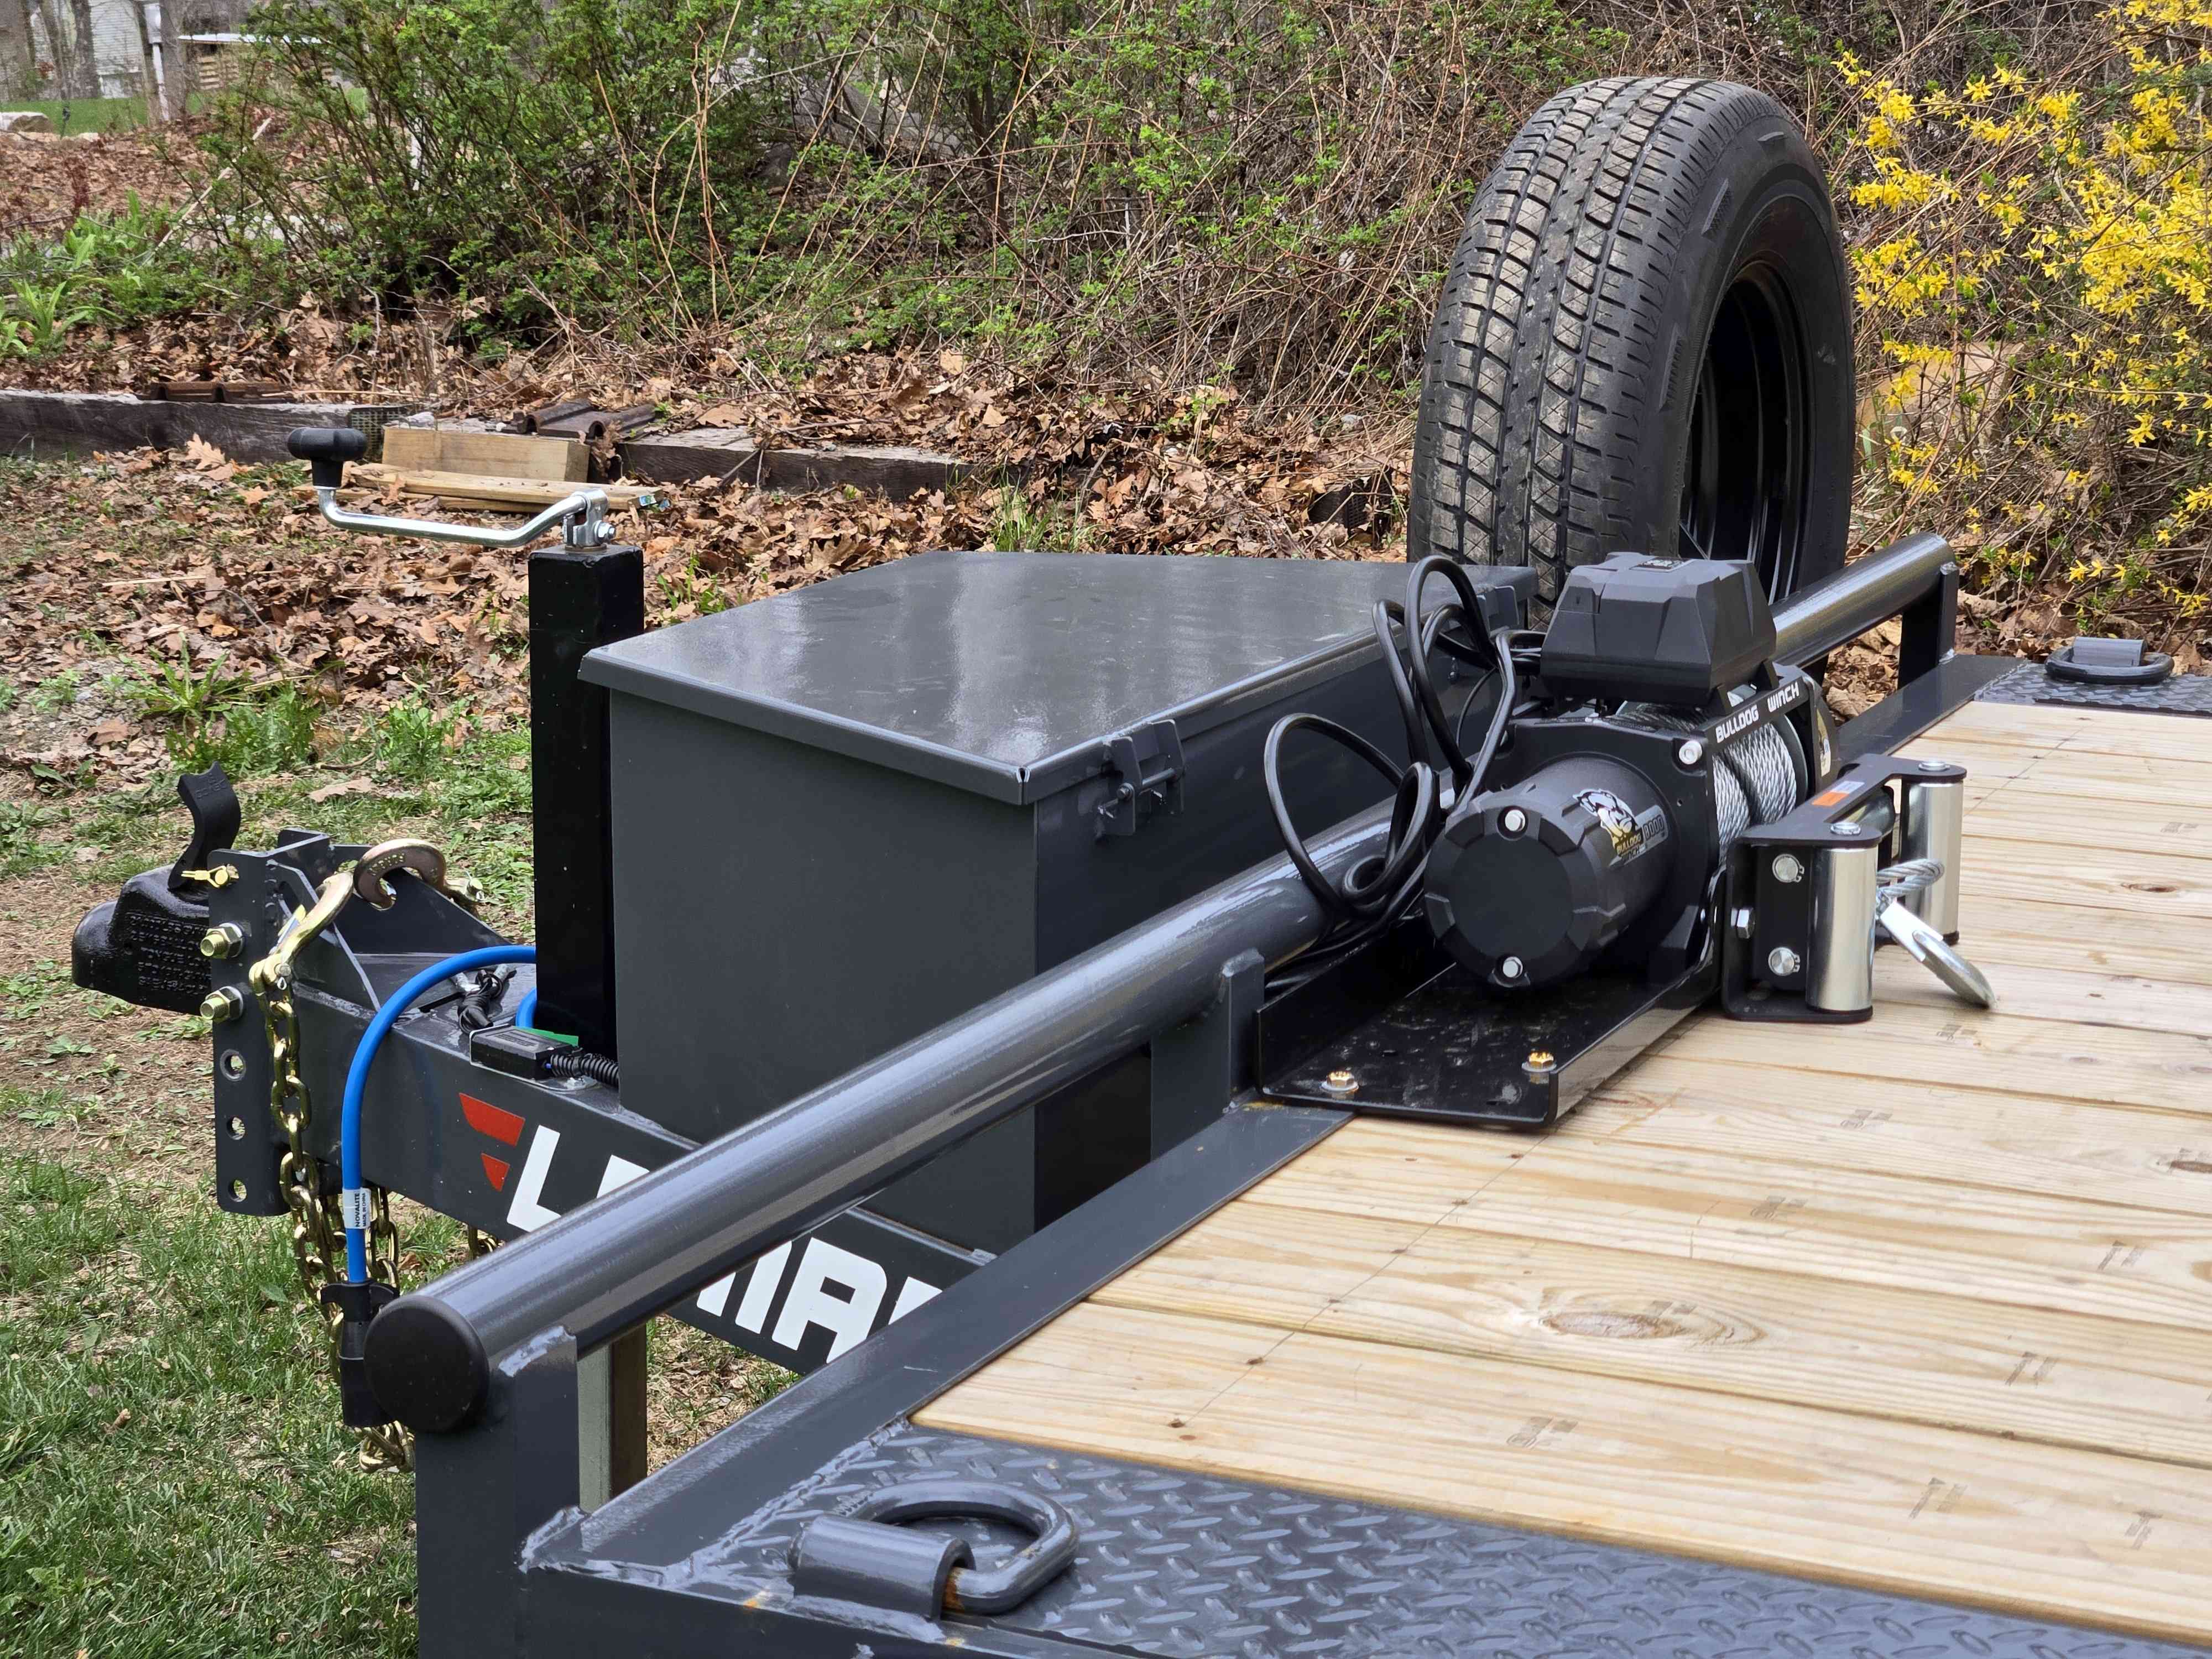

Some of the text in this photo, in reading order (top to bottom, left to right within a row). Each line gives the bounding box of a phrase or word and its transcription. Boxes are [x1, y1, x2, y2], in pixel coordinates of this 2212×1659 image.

[1715, 681, 1799, 743] BULLDOG WINCH
[1643, 816, 1665, 841] 8000
[1616, 833, 1642, 855] BULLDOG
